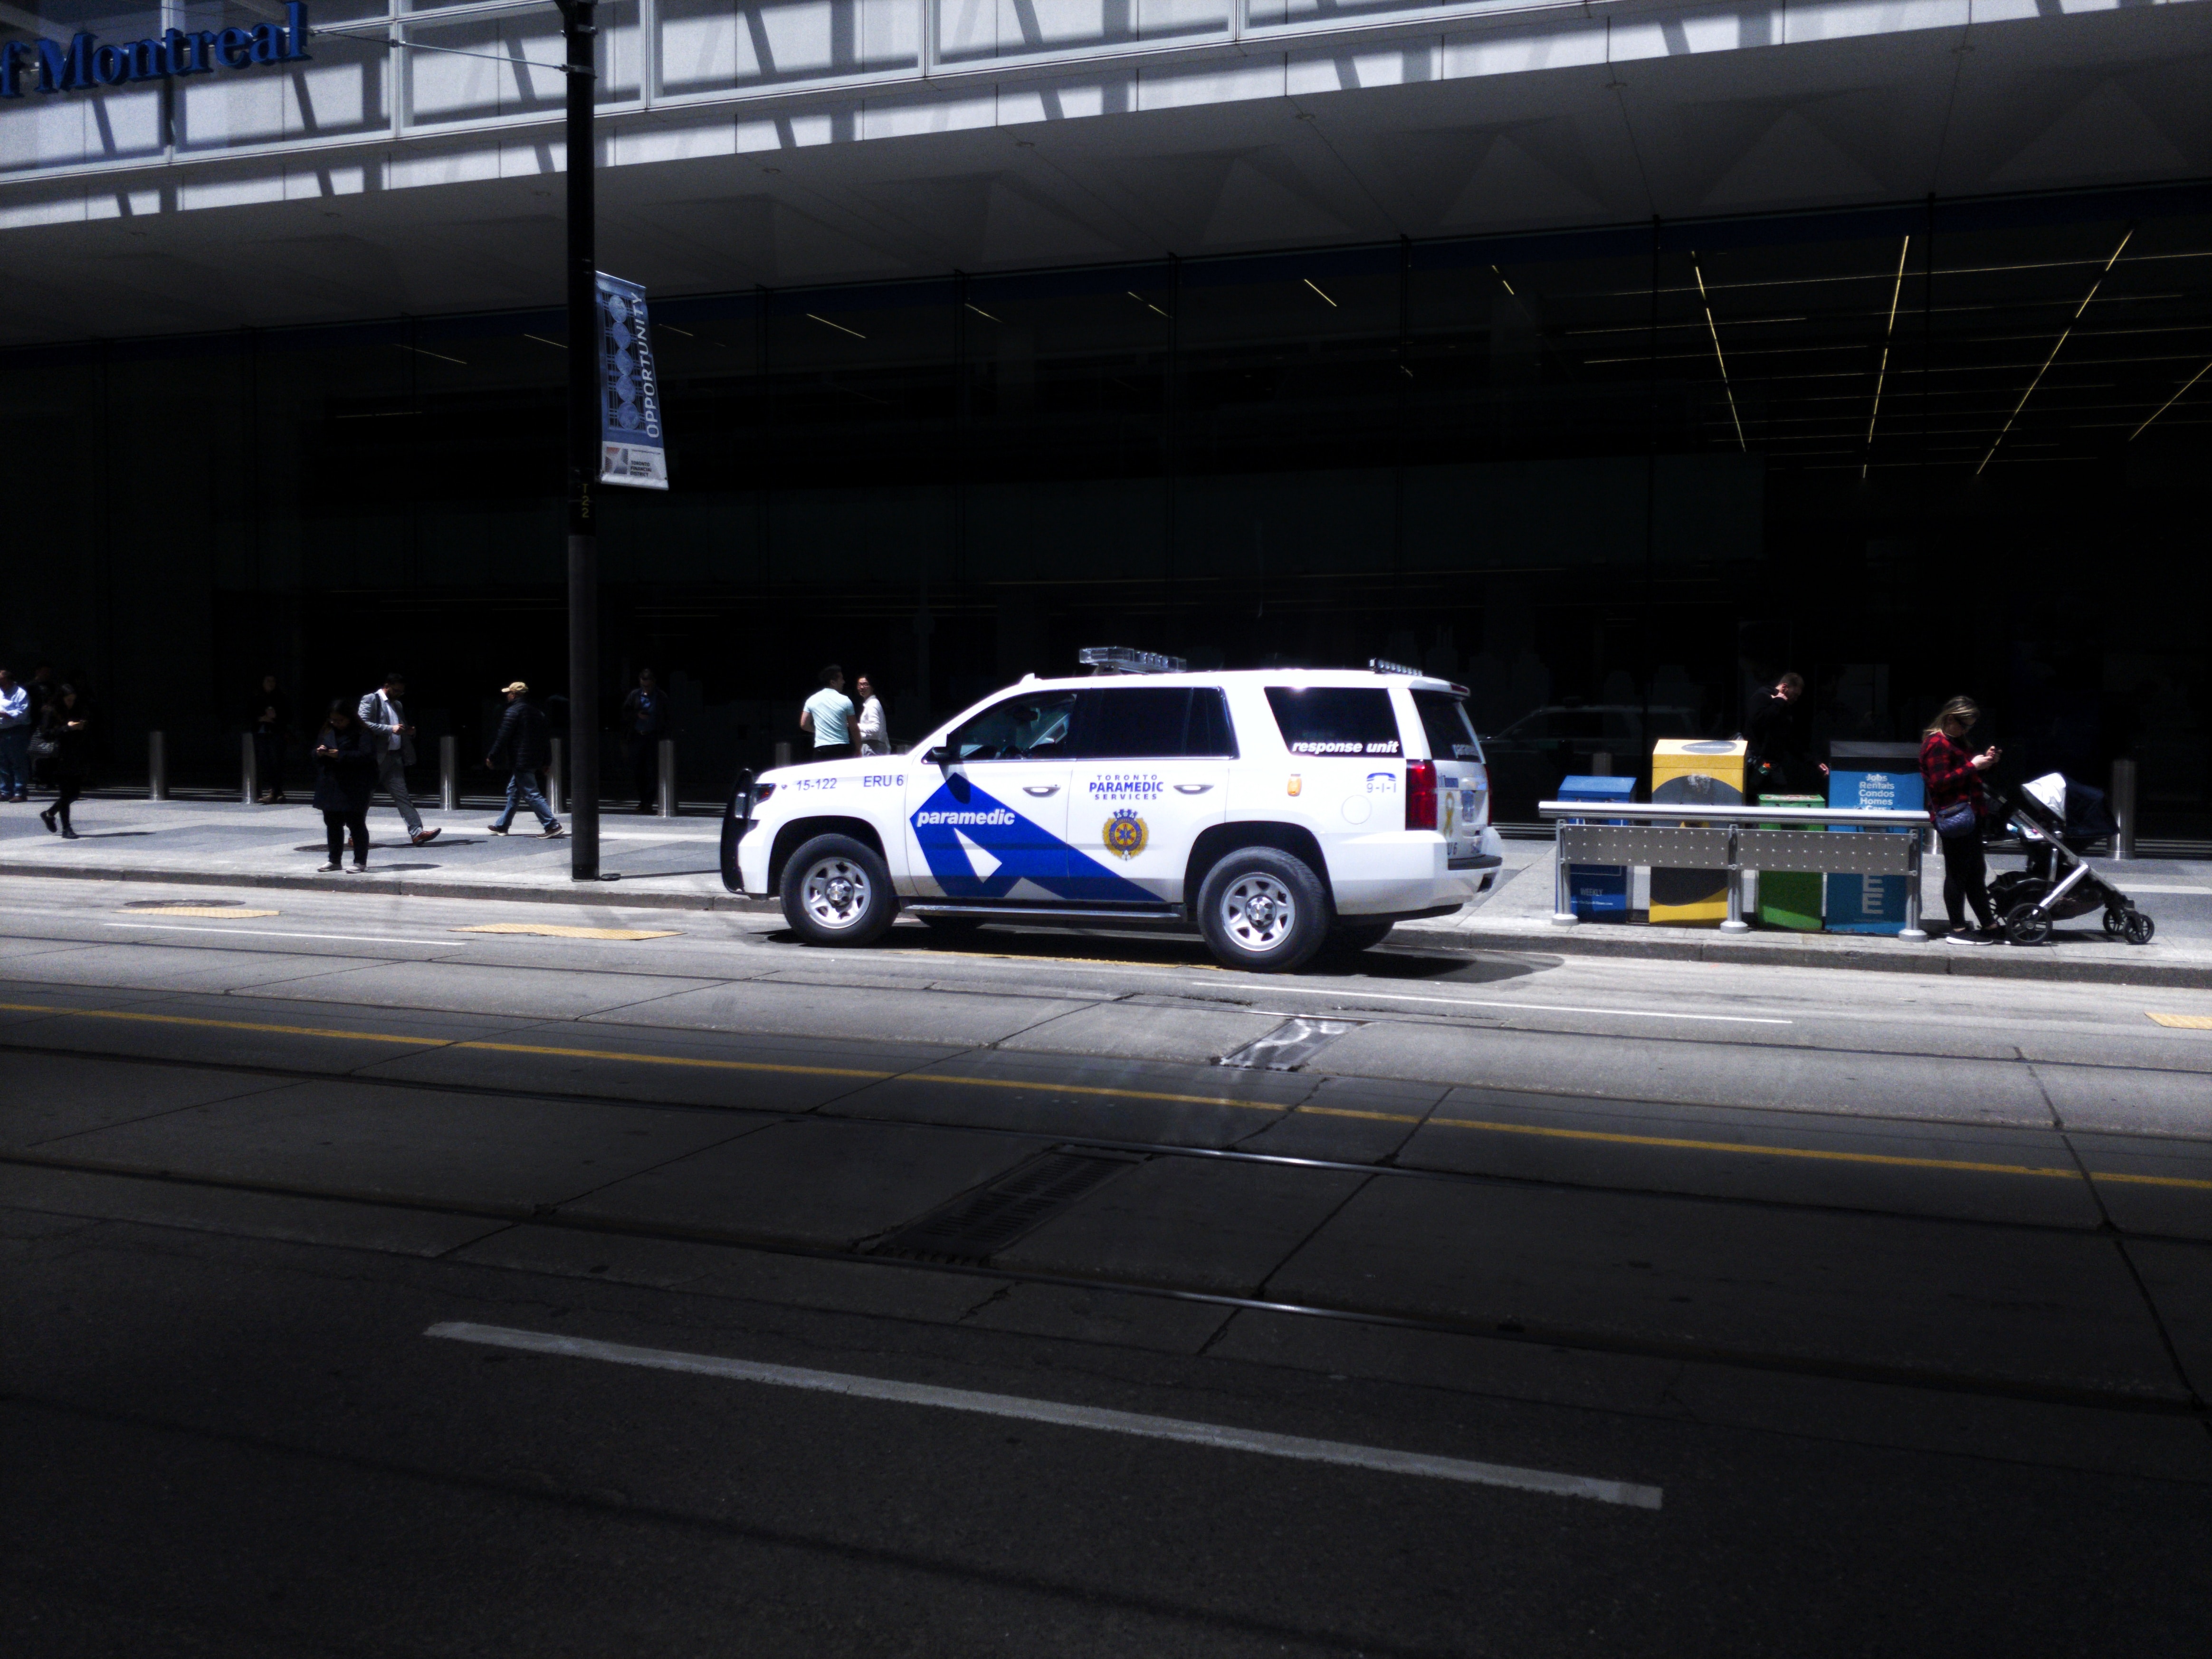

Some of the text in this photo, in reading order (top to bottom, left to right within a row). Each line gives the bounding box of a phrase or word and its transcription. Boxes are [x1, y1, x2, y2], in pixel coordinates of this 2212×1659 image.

[34, 0, 313, 94] Montreal
[631, 292, 659, 438] OPPORTUNITY
[1292, 741, 1399, 754] response unit
[863, 774, 904, 787] ERU 6
[1866, 773, 1888, 782] Jobs
[797, 778, 838, 791] 15-122
[1089, 782, 1164, 792] PARAMEDIC
[1366, 783, 1396, 793] 9-1-1
[1859, 782, 1895, 790] Rentals
[1859, 789, 1895, 798] Condos
[1860, 797, 1893, 805] Homes
[917, 809, 1015, 828] paramedic
